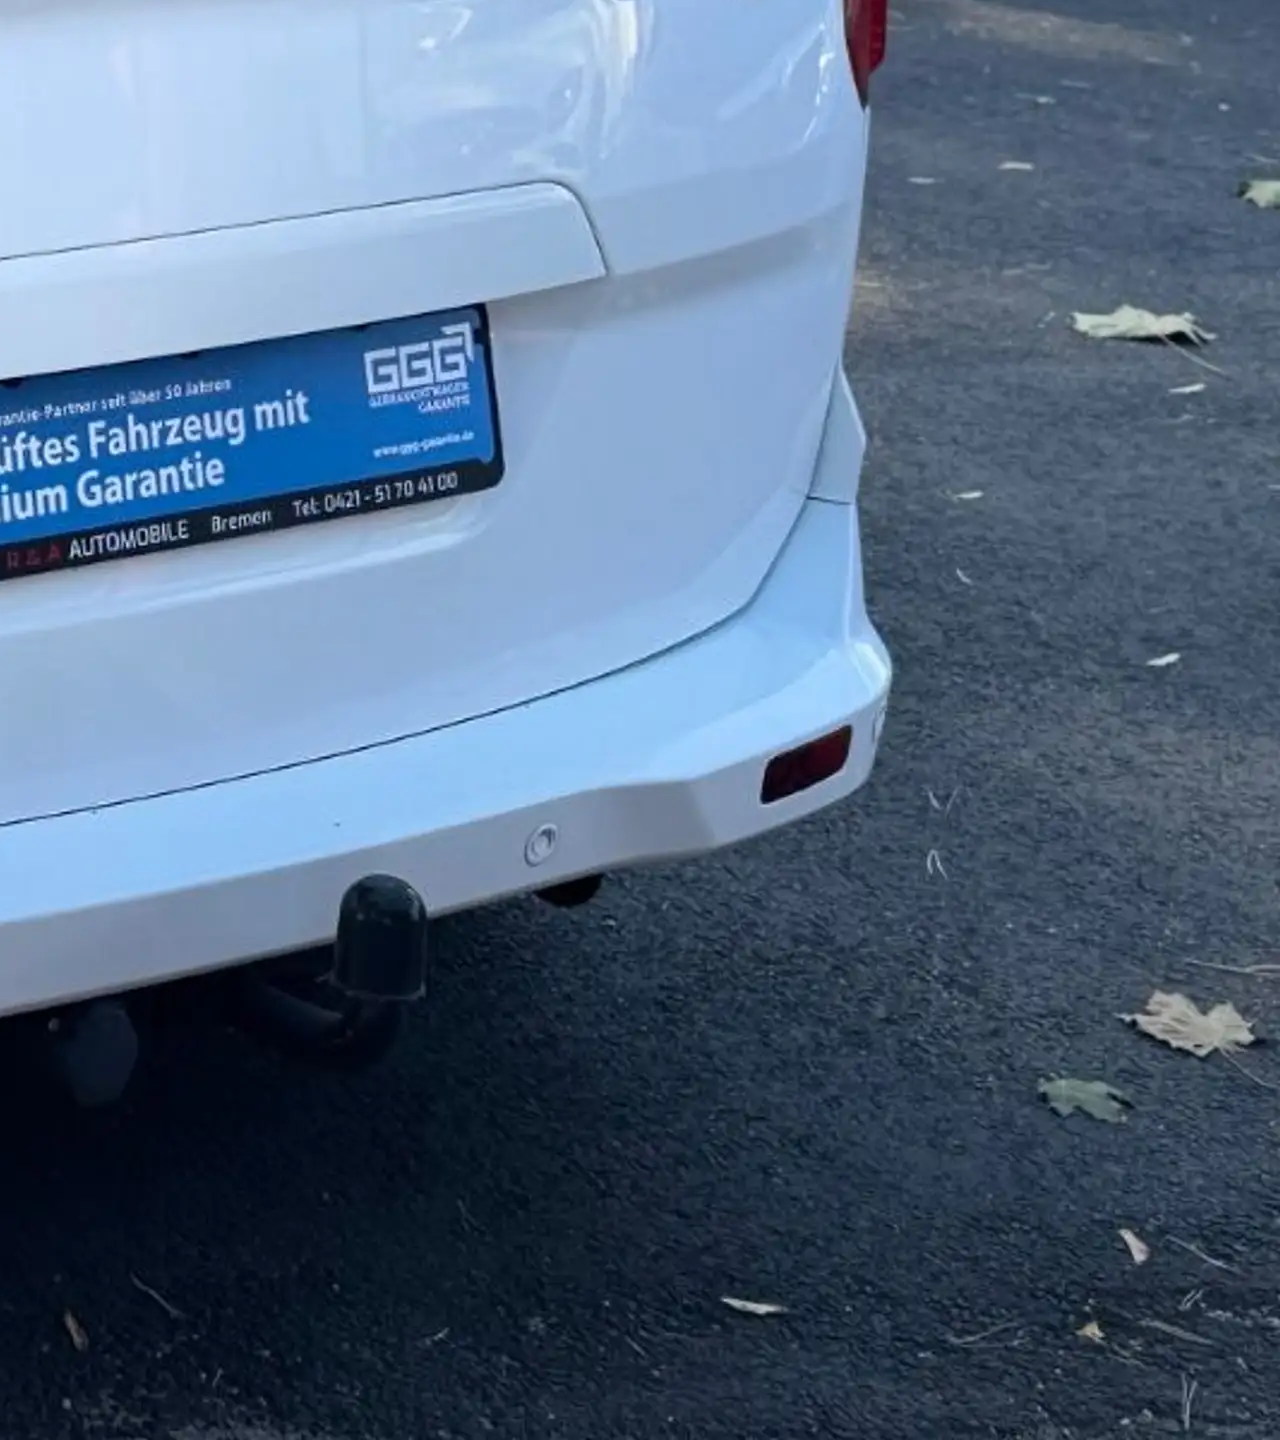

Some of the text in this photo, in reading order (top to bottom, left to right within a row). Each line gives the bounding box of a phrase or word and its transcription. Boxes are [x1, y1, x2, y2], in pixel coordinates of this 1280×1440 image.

[364, 334, 469, 394] GGG
[87, 413, 246, 459] Fahrzeug
[254, 389, 310, 431] mit
[100, 393, 127, 411] seit
[129, 388, 162, 405] über
[165, 383, 183, 400] 50
[185, 378, 233, 398] Jahren
[76, 450, 226, 510] Garantie
[68, 519, 190, 559] AUTOMOBILE
[211, 508, 273, 534] Bremen
[324, 488, 361, 514] 0421
[374, 483, 392, 504] 51
[395, 479, 415, 499] 70
[418, 475, 435, 494] 41
[436, 470, 459, 491] 00
